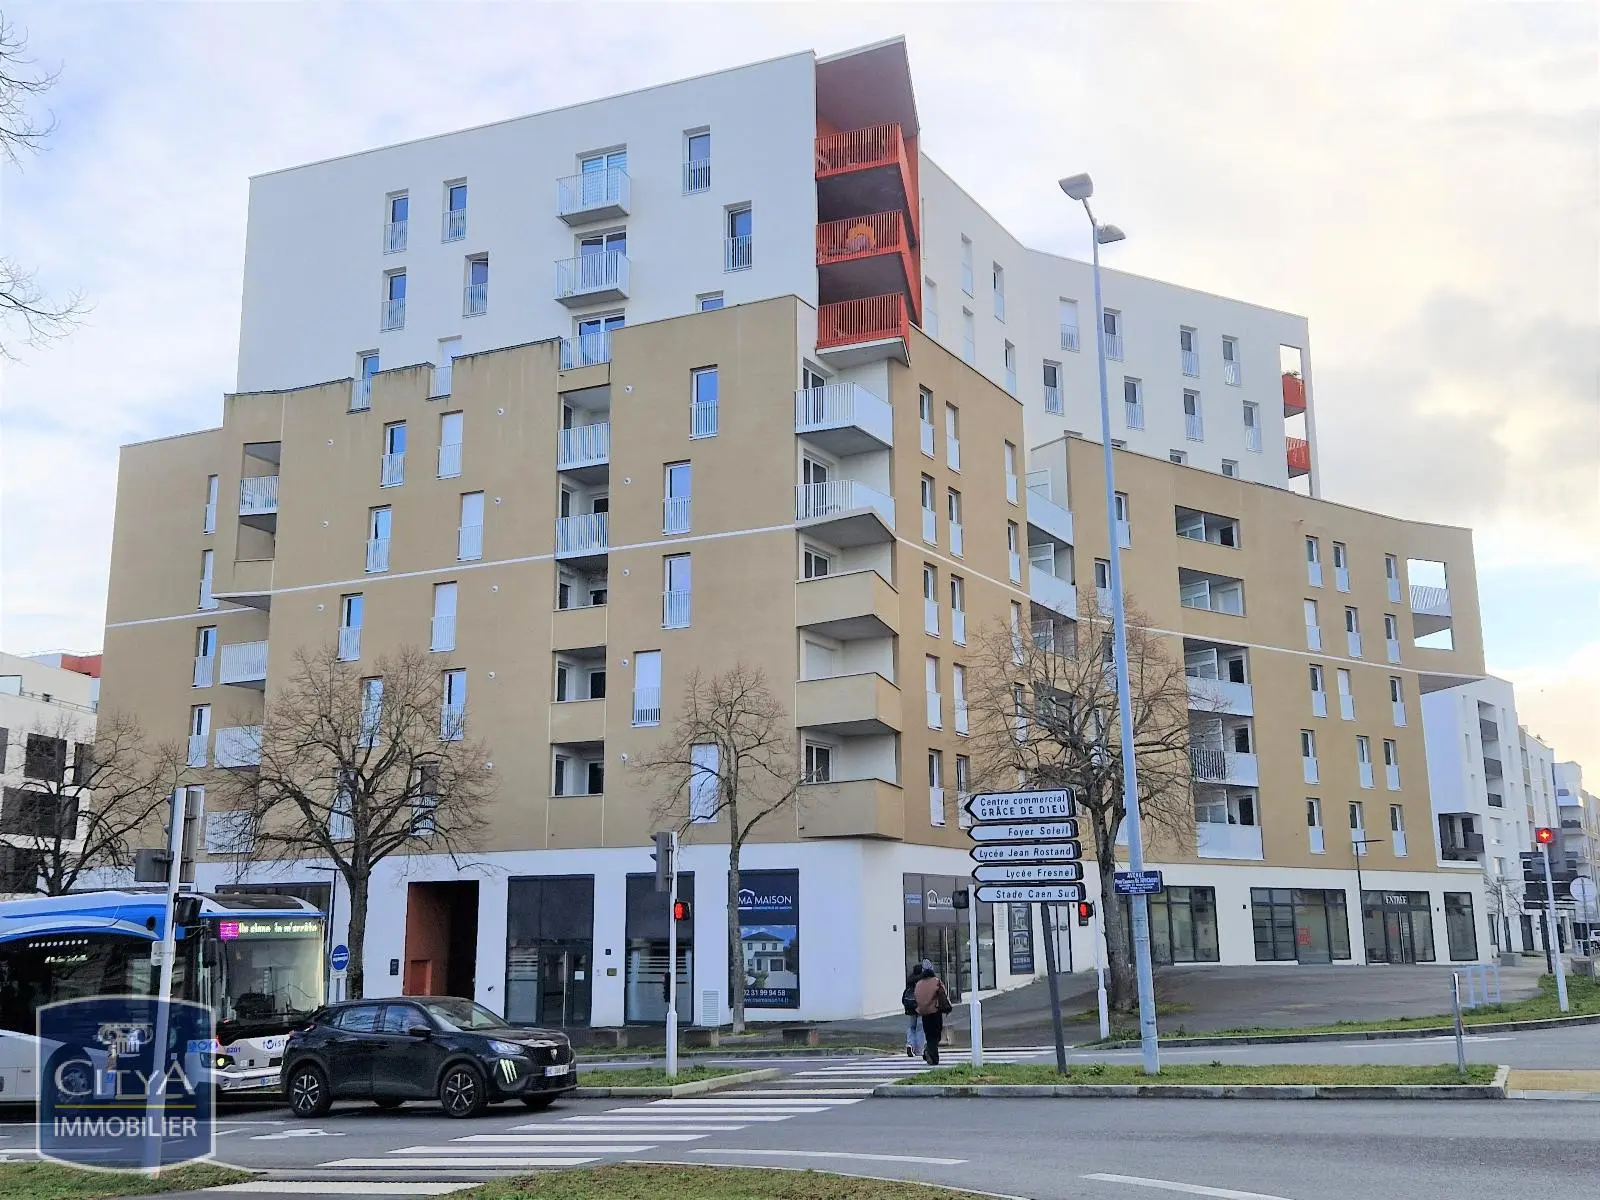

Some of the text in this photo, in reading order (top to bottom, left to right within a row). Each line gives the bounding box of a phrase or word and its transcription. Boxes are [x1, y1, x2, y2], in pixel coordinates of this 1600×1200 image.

[980, 794, 1065, 806] Centre commercial
[1020, 806, 1034, 815] DE
[1039, 804, 1066, 814] DIEU
[1008, 825, 1069, 838] Foyer Soleil
[979, 847, 1071, 859] Lycée Jean Rostand
[1006, 868, 1074, 878] Lycée Fresnel
[996, 889, 1076, 899] Stade Caen Sud
[738, 895, 792, 905] MA MAISON
[777, 989, 786, 997] 58
